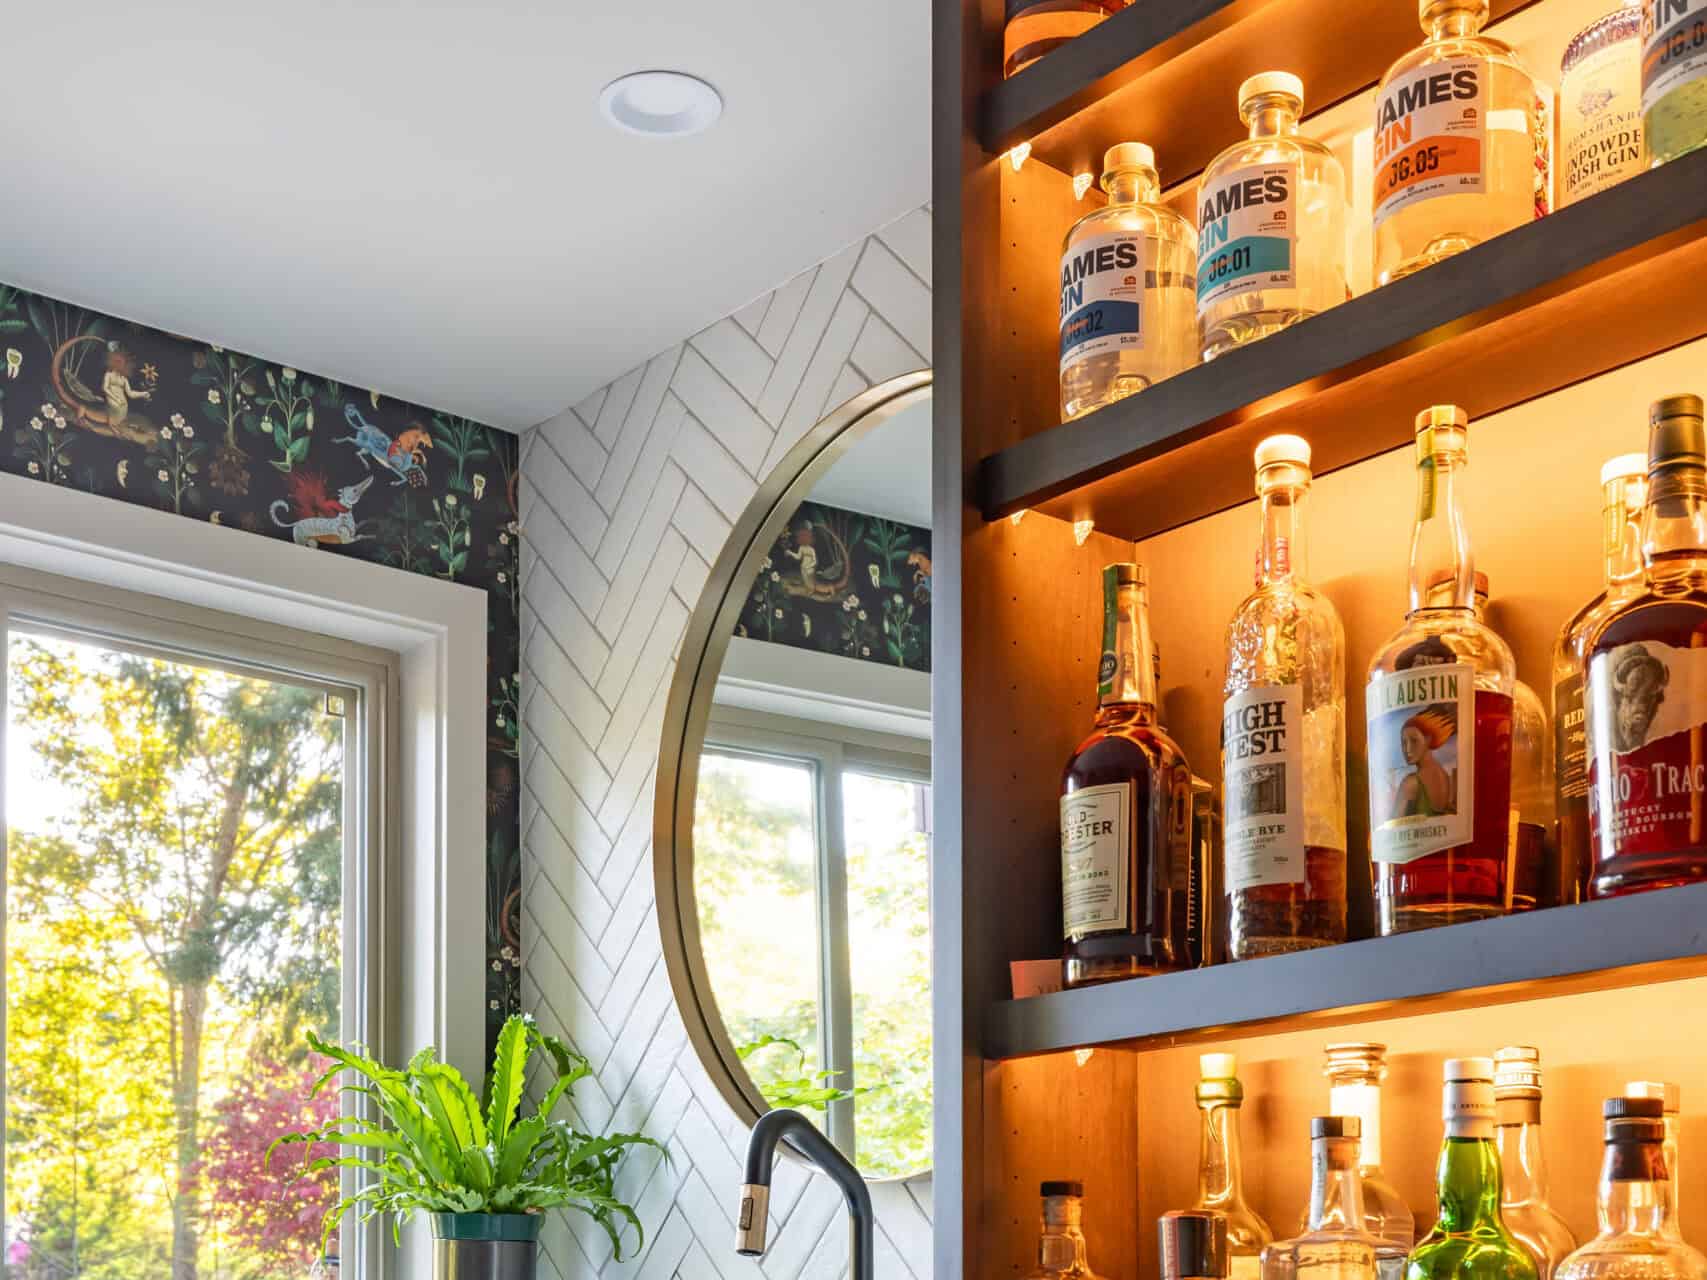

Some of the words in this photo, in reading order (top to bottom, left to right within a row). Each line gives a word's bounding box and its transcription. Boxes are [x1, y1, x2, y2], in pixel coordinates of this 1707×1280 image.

[1389, 146, 1440, 187] JG.05
[1607, 145, 1639, 166] GIN
[1062, 243, 1138, 290] AMES
[1209, 245, 1251, 282] JG.01
[1063, 280, 1083, 315] IN
[1397, 674, 1459, 705] AUSTIN
[1259, 824, 1286, 836] RYE
[1413, 825, 1448, 840] WHISKEY
